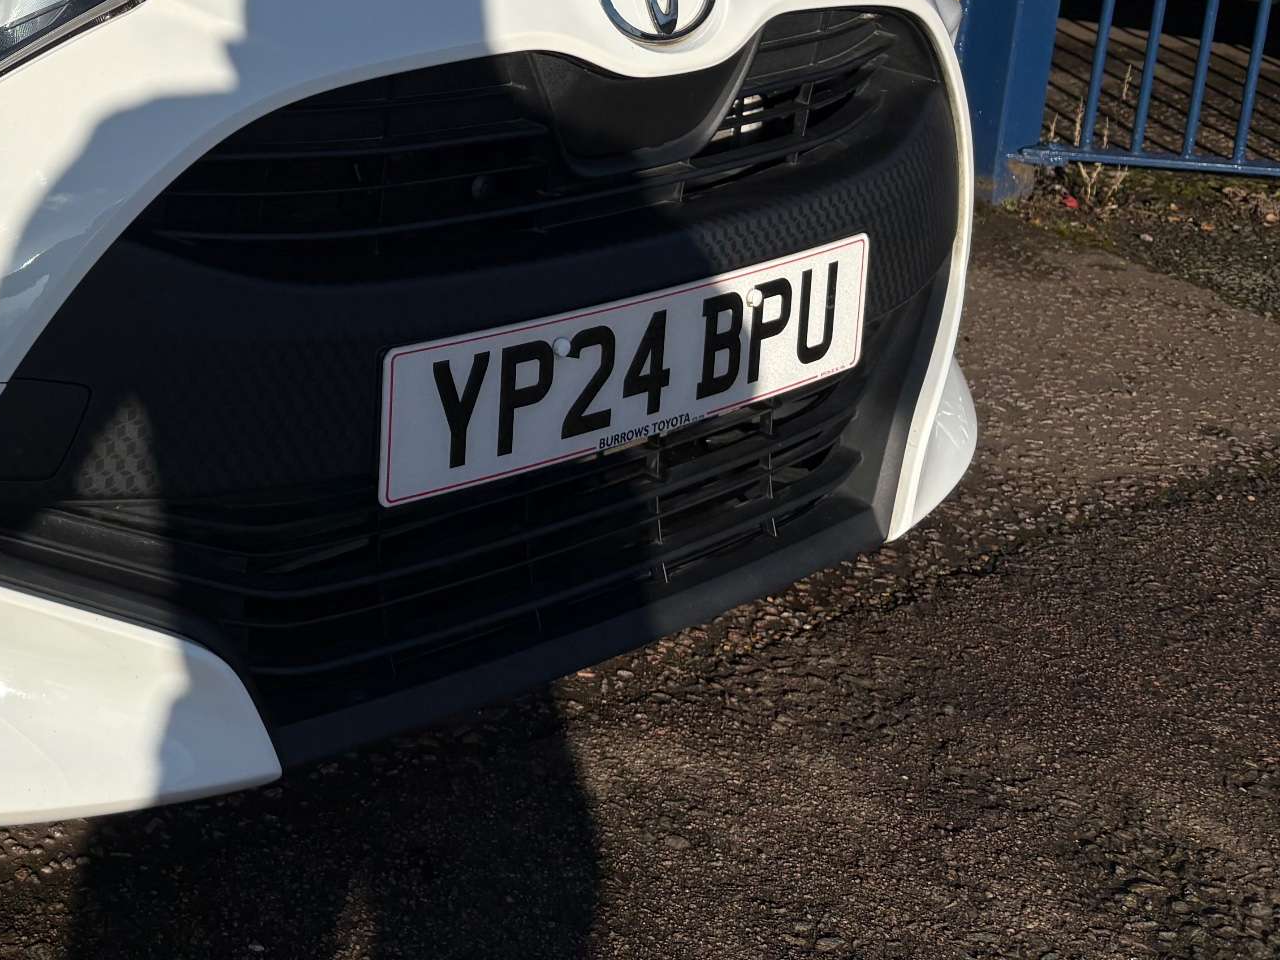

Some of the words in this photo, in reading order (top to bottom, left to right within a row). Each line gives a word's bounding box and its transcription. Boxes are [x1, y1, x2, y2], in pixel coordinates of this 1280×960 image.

[432, 309, 671, 469] YP24
[696, 260, 839, 401] BPU
[599, 424, 650, 450] BURROWS
[651, 412, 691, 436] TOYOTA
